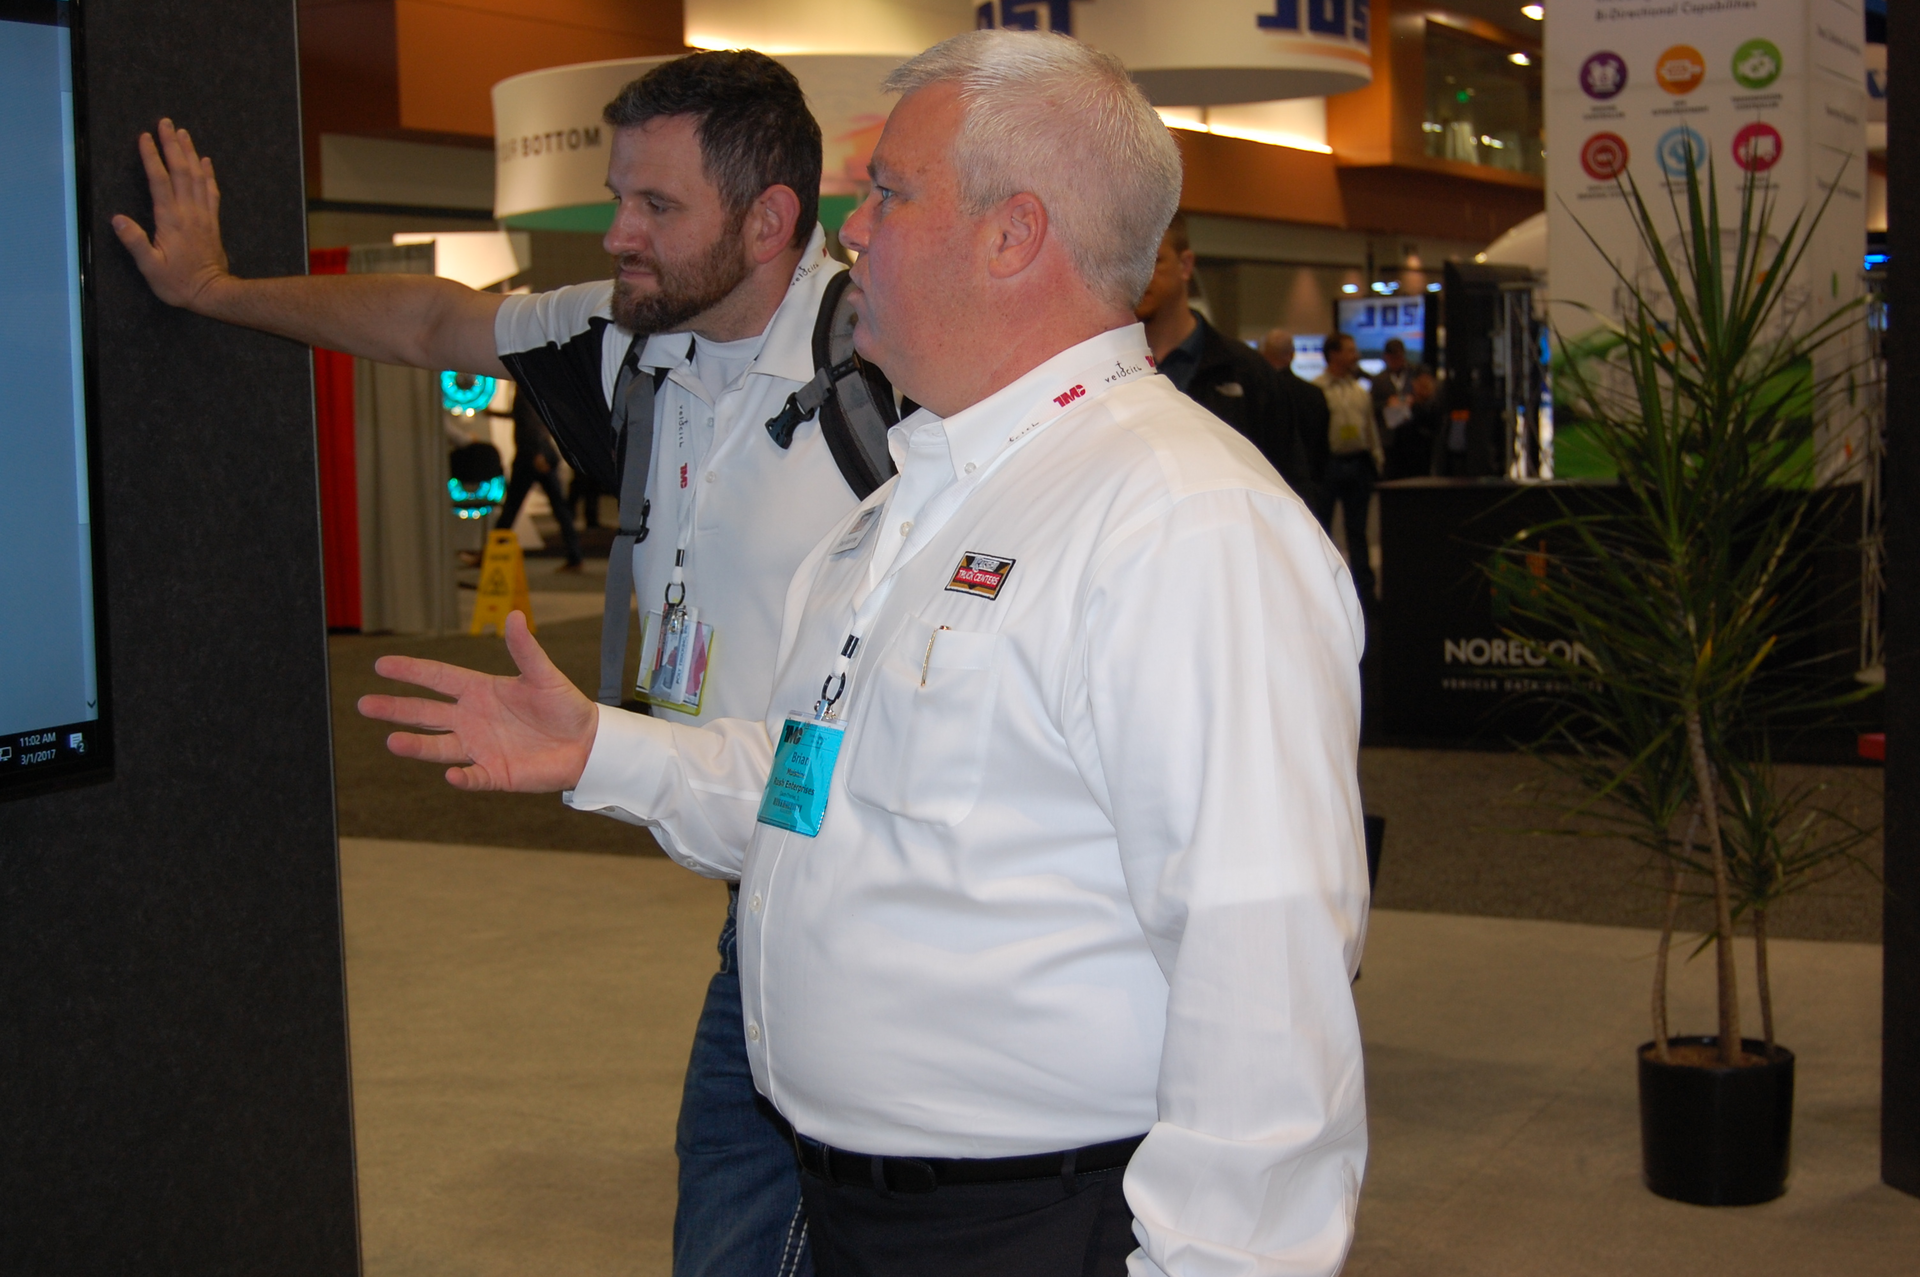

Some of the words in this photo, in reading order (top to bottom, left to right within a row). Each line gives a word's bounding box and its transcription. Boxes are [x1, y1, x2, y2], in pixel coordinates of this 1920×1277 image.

[522, 126, 600, 157] BOTTOM
[1053, 384, 1086, 408] TMC
[20, 736, 40, 747] 11:02
[42, 732, 56, 743] AM
[21, 749, 56, 765] 3/1/2017
[785, 780, 815, 796] Enterprises
